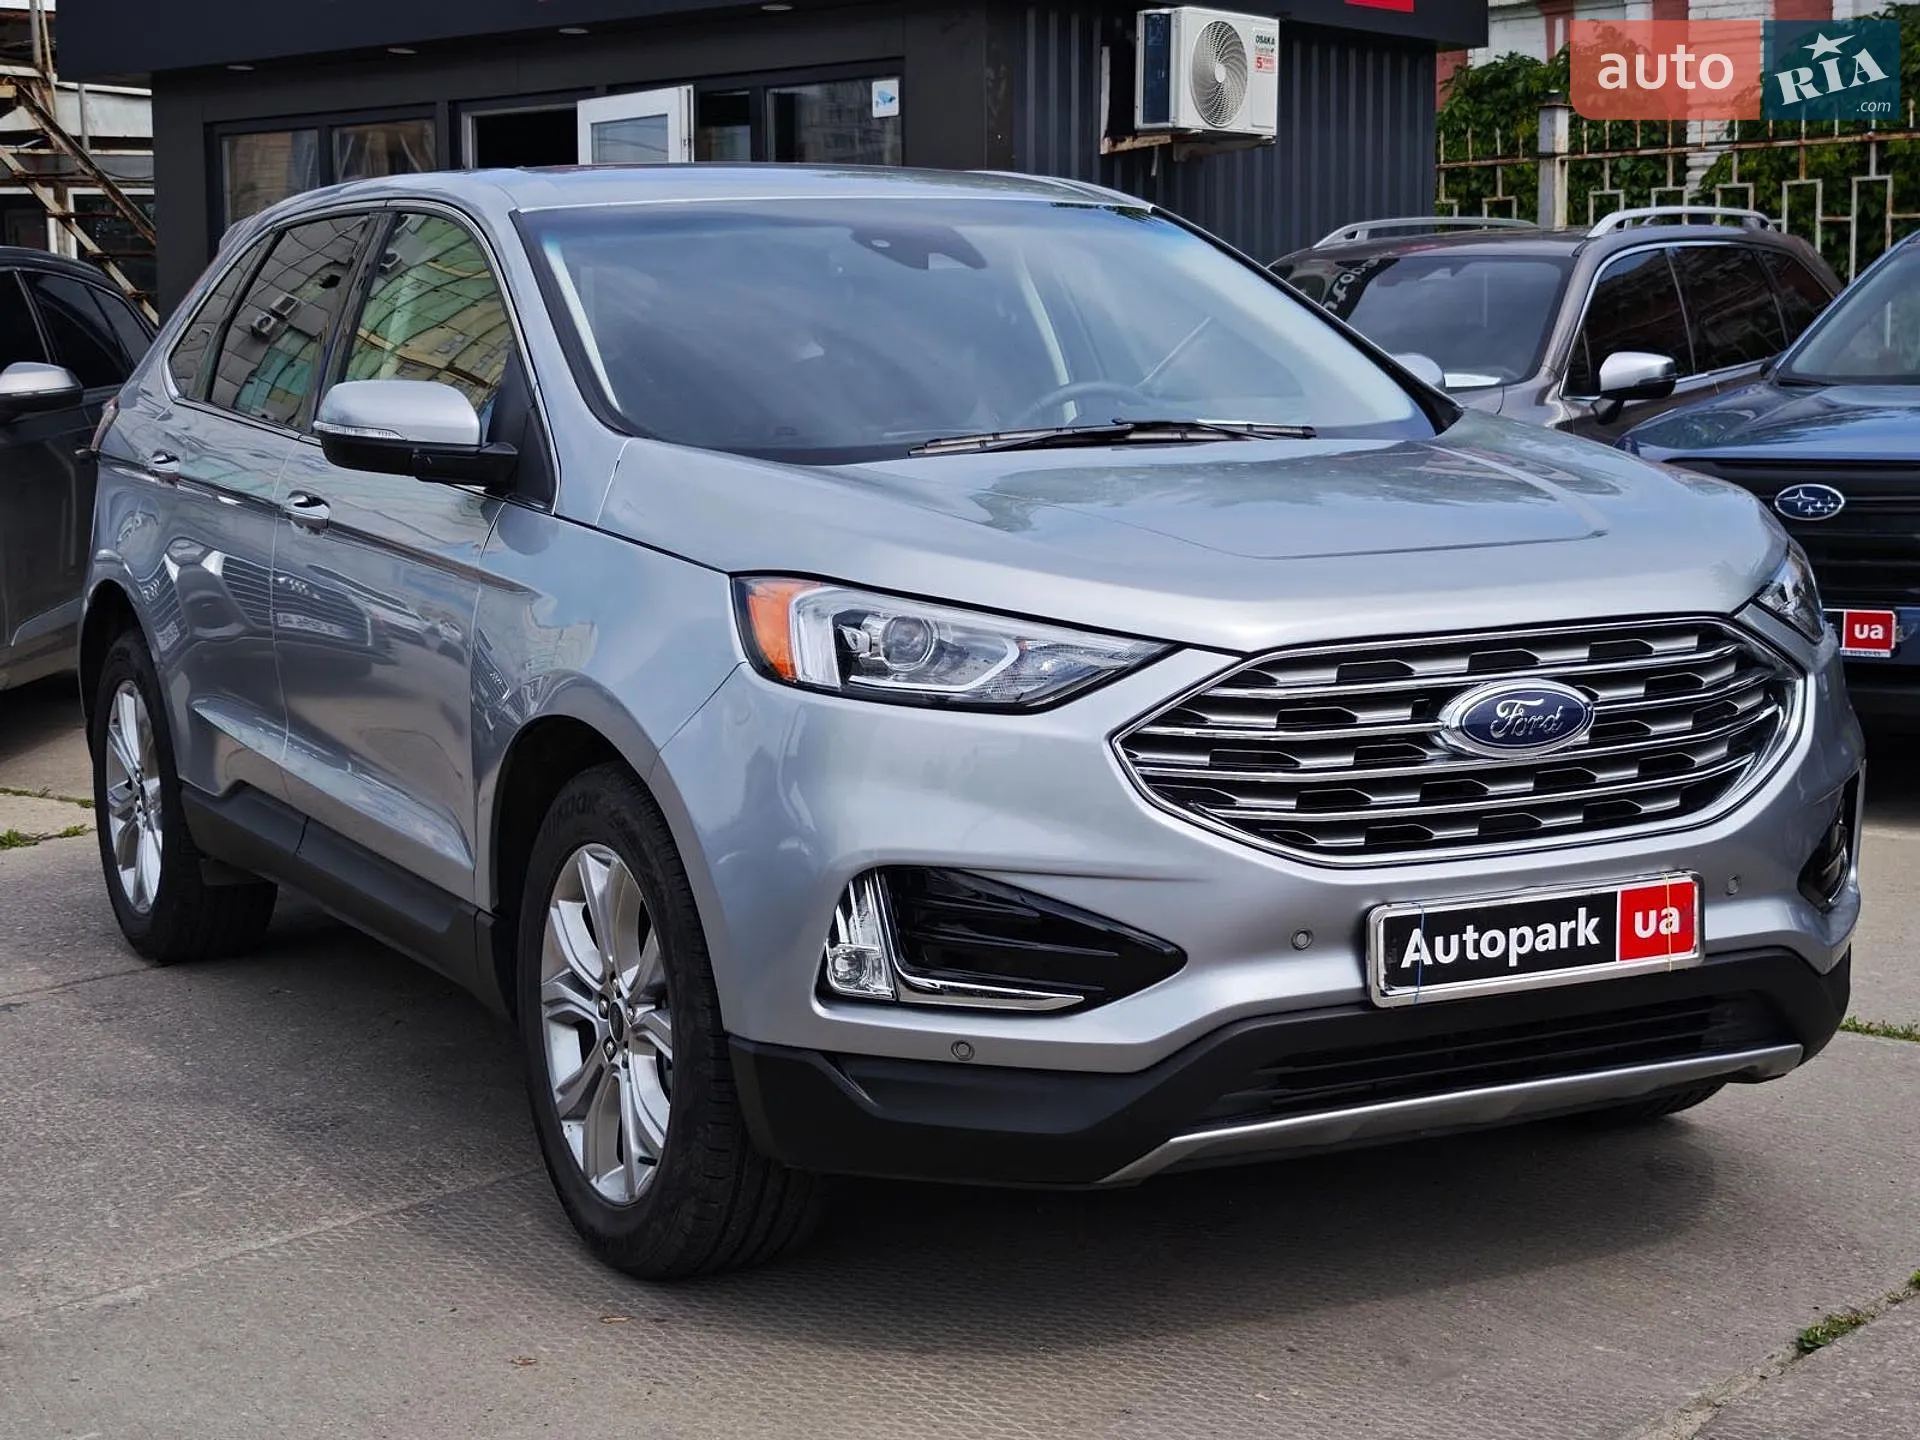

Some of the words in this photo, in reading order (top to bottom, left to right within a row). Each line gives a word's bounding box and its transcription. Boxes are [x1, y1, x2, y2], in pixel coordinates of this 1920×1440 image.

[1256, 56, 1263, 69] 5
[1854, 623, 1883, 640] ua
[1490, 698, 1564, 739] Ford
[1400, 907, 1600, 967] Autopark
[1634, 905, 1680, 939] ua
